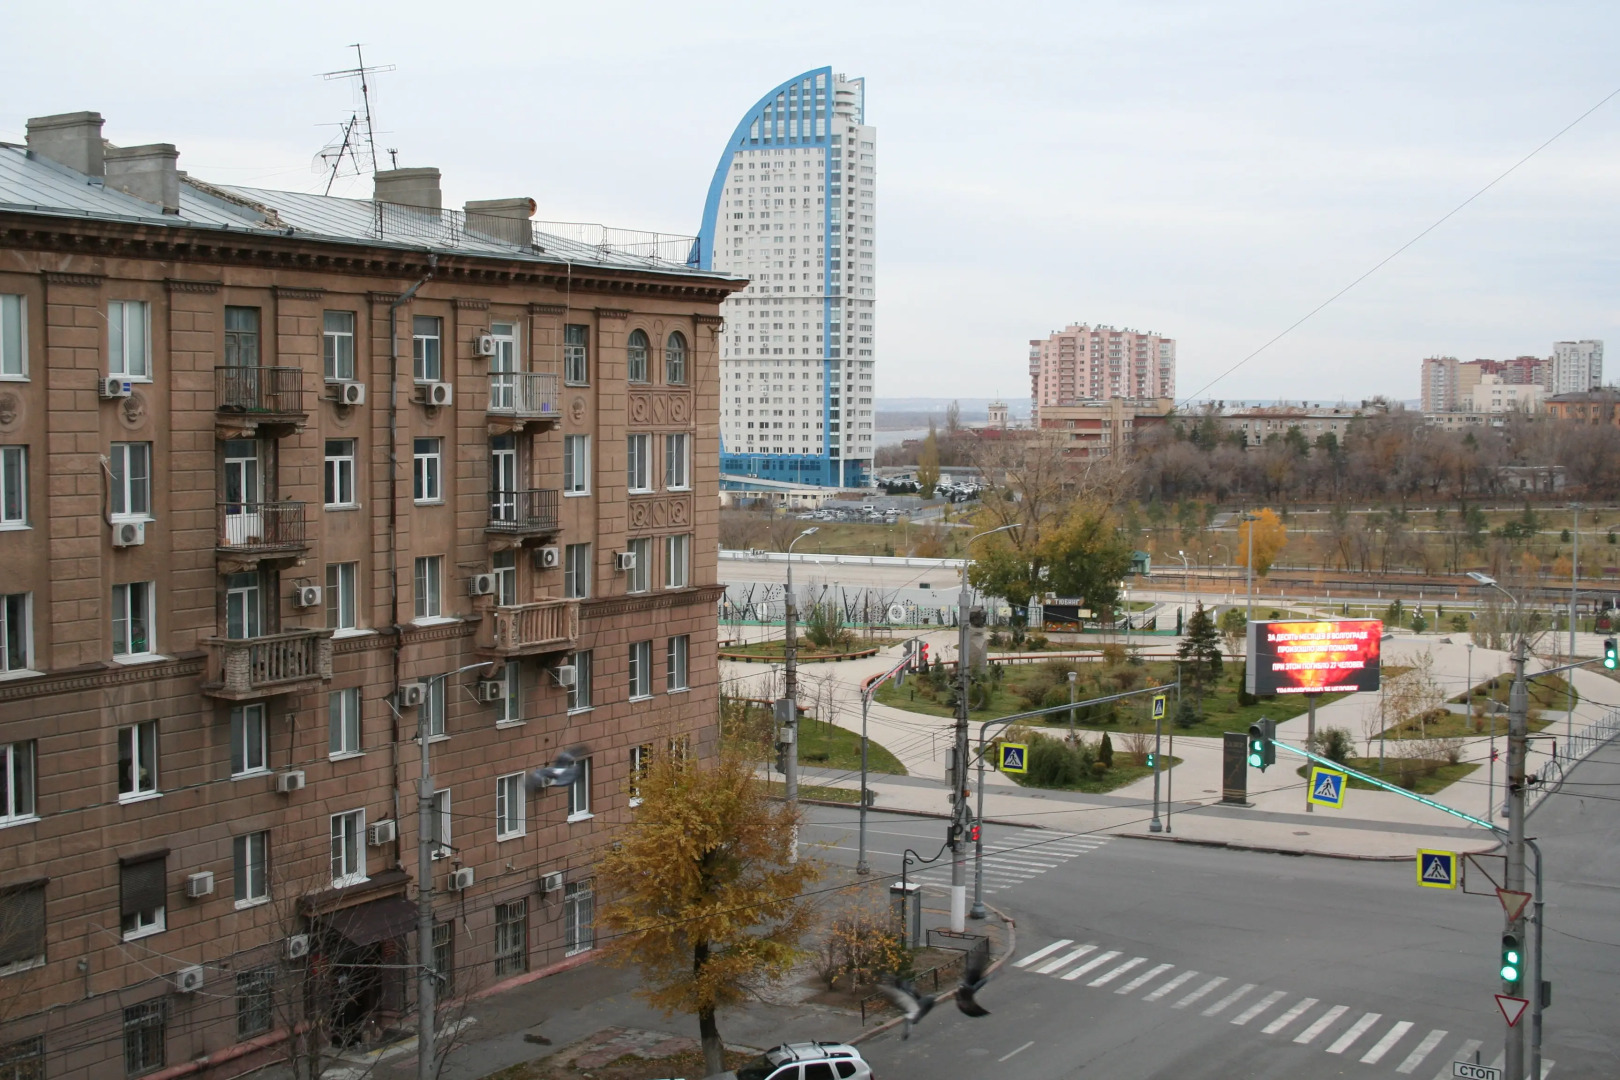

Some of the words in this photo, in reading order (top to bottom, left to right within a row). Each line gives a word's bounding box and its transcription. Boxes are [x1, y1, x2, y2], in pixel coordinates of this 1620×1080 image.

[1268, 633, 1275, 641] ЗА
[1276, 633, 1298, 642] ДЕСЯТЬ
[1299, 632, 1325, 640] МЕСЯЦЕВ
[1332, 631, 1368, 640] ВОЛГОГРАДЕ
[1278, 645, 1315, 653] ПРОИЗОШЛО
[1329, 644, 1358, 652] ПОЖАРОВ
[1272, 662, 1285, 671] ПРИ
[1285, 662, 1301, 670] ЭТОМ
[1302, 662, 1329, 670] ПОГИБЛО
[1330, 661, 1336, 669] 27
[1337, 660, 1365, 669] ЧЕЛОВЕК
[1459, 1065, 1495, 1080] СТОП
